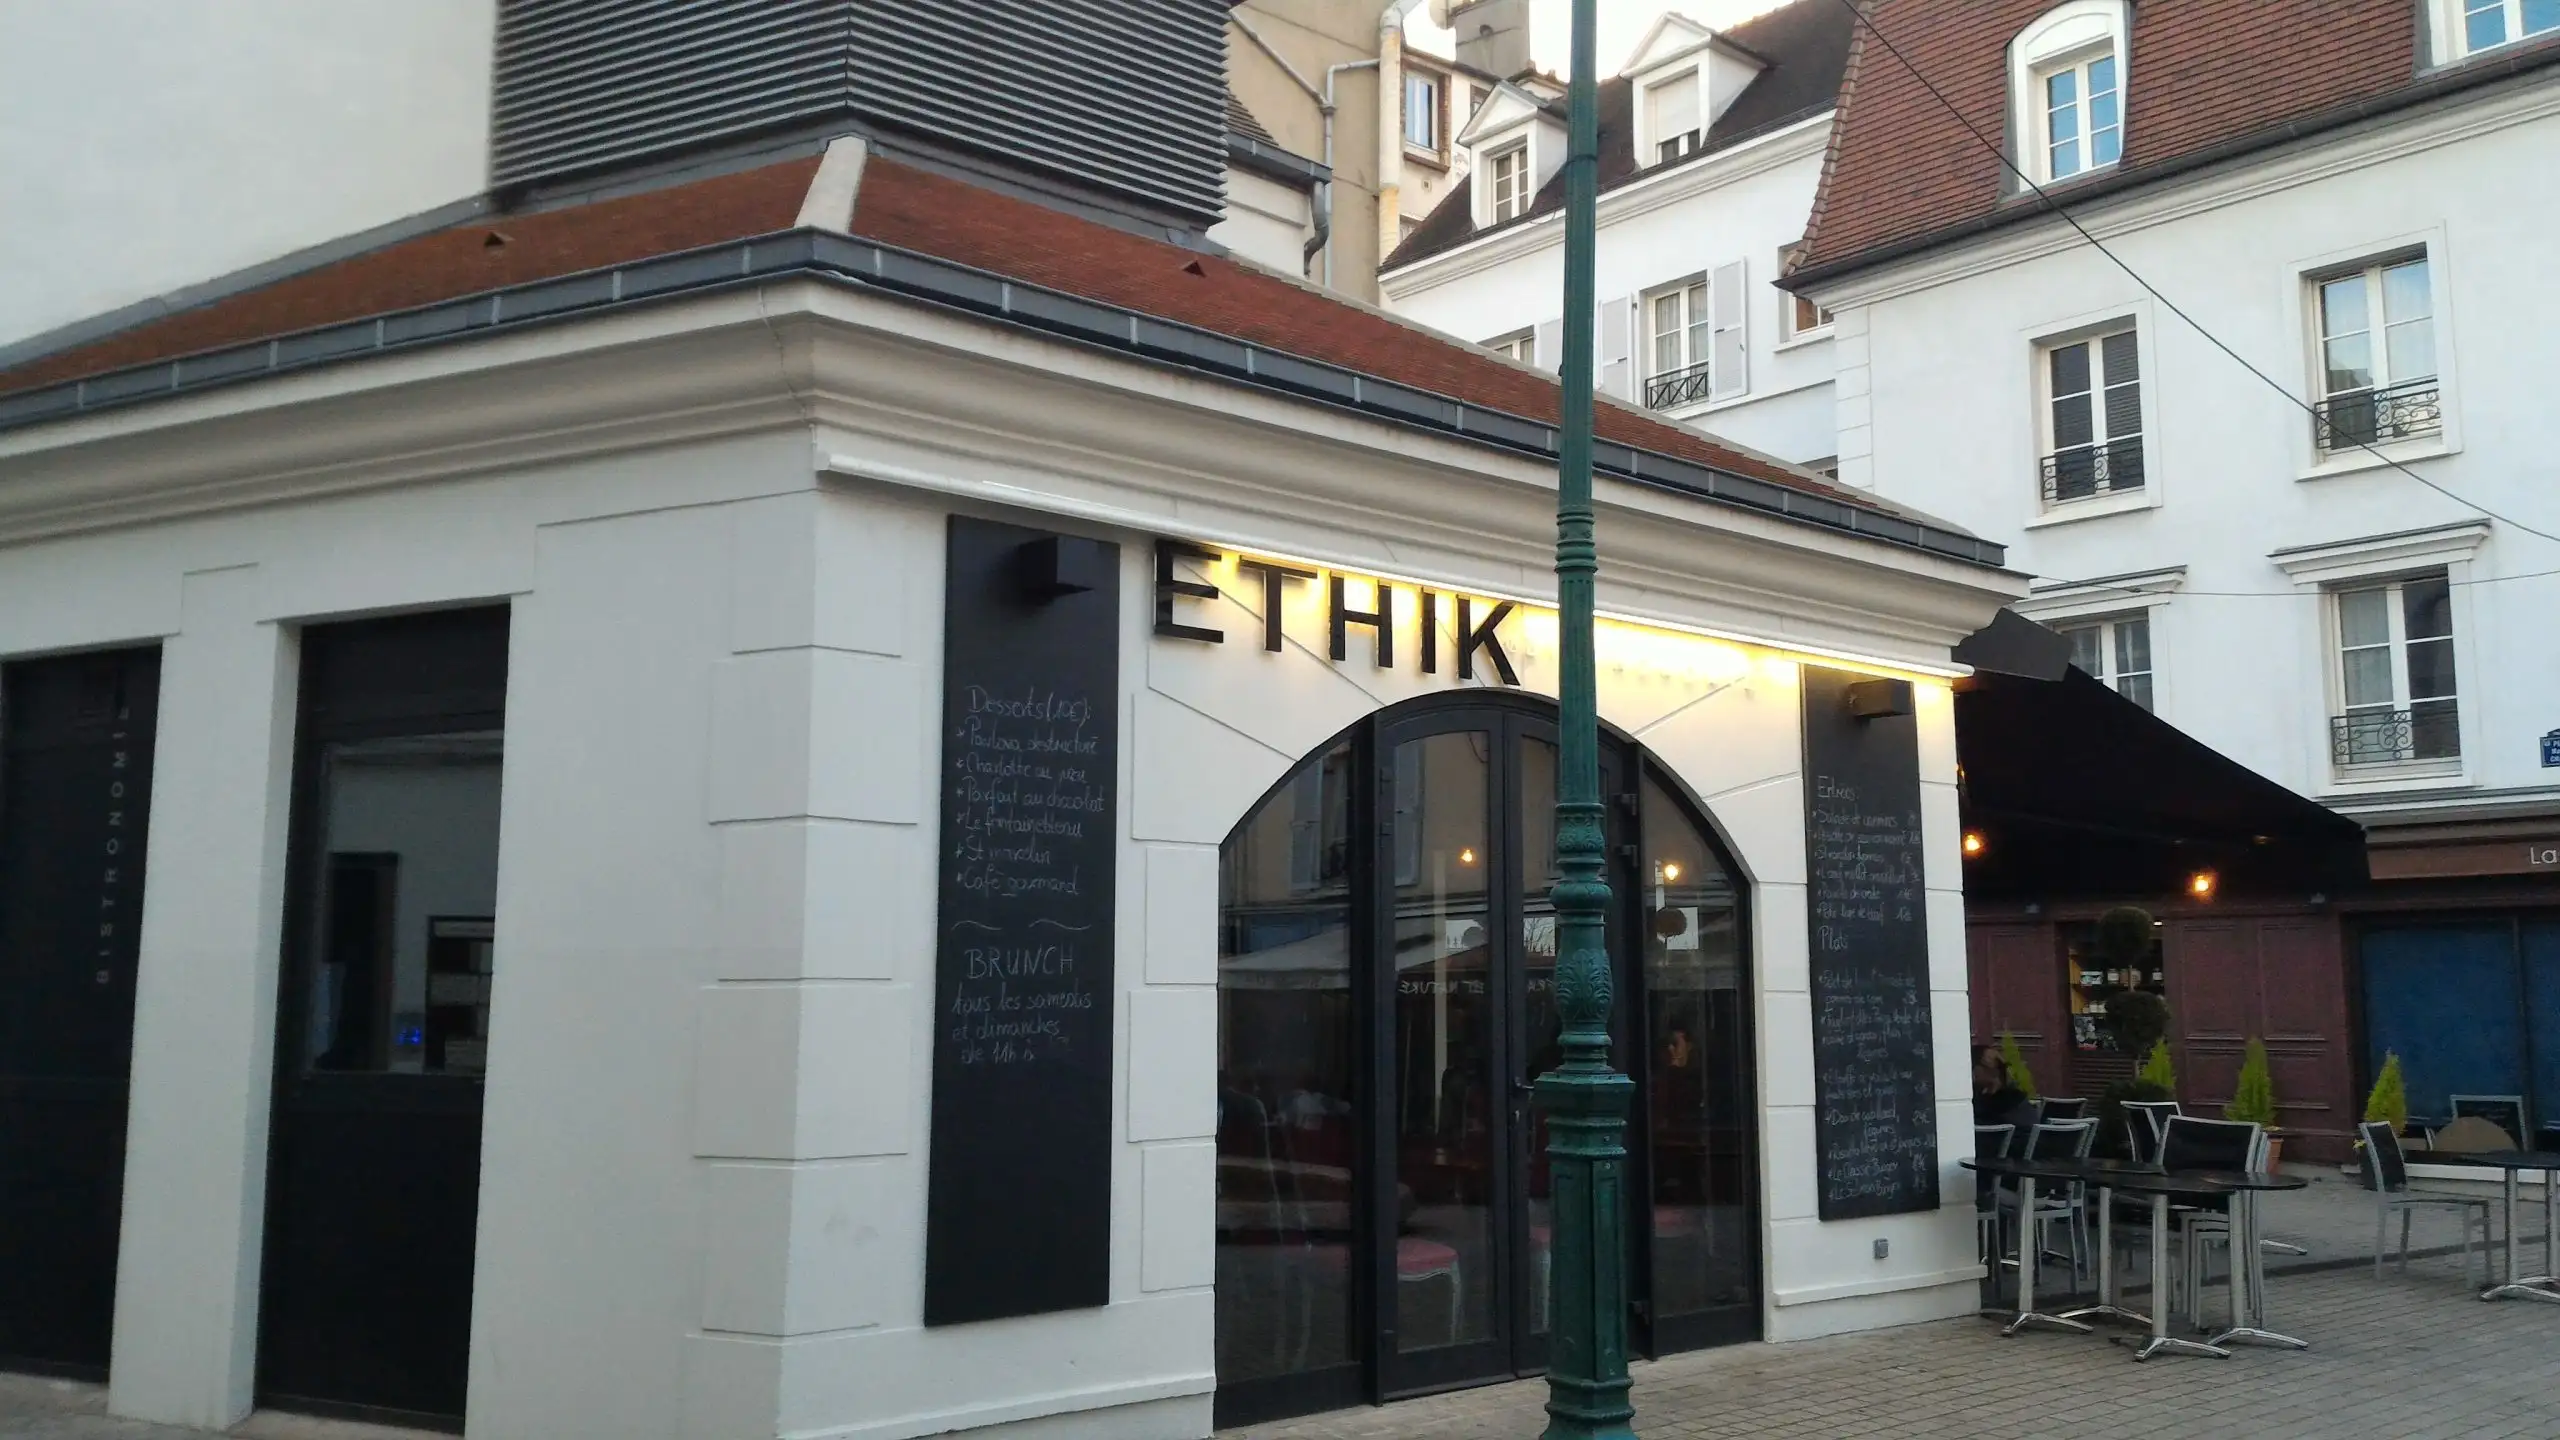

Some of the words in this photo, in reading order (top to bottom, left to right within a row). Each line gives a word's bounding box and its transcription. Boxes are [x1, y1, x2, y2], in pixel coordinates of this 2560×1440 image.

[1154, 539, 1521, 685] ETHIK
[964, 942, 1074, 979] BRUNCH
[951, 982, 992, 1015] tous
[997, 981, 1021, 1011] les
